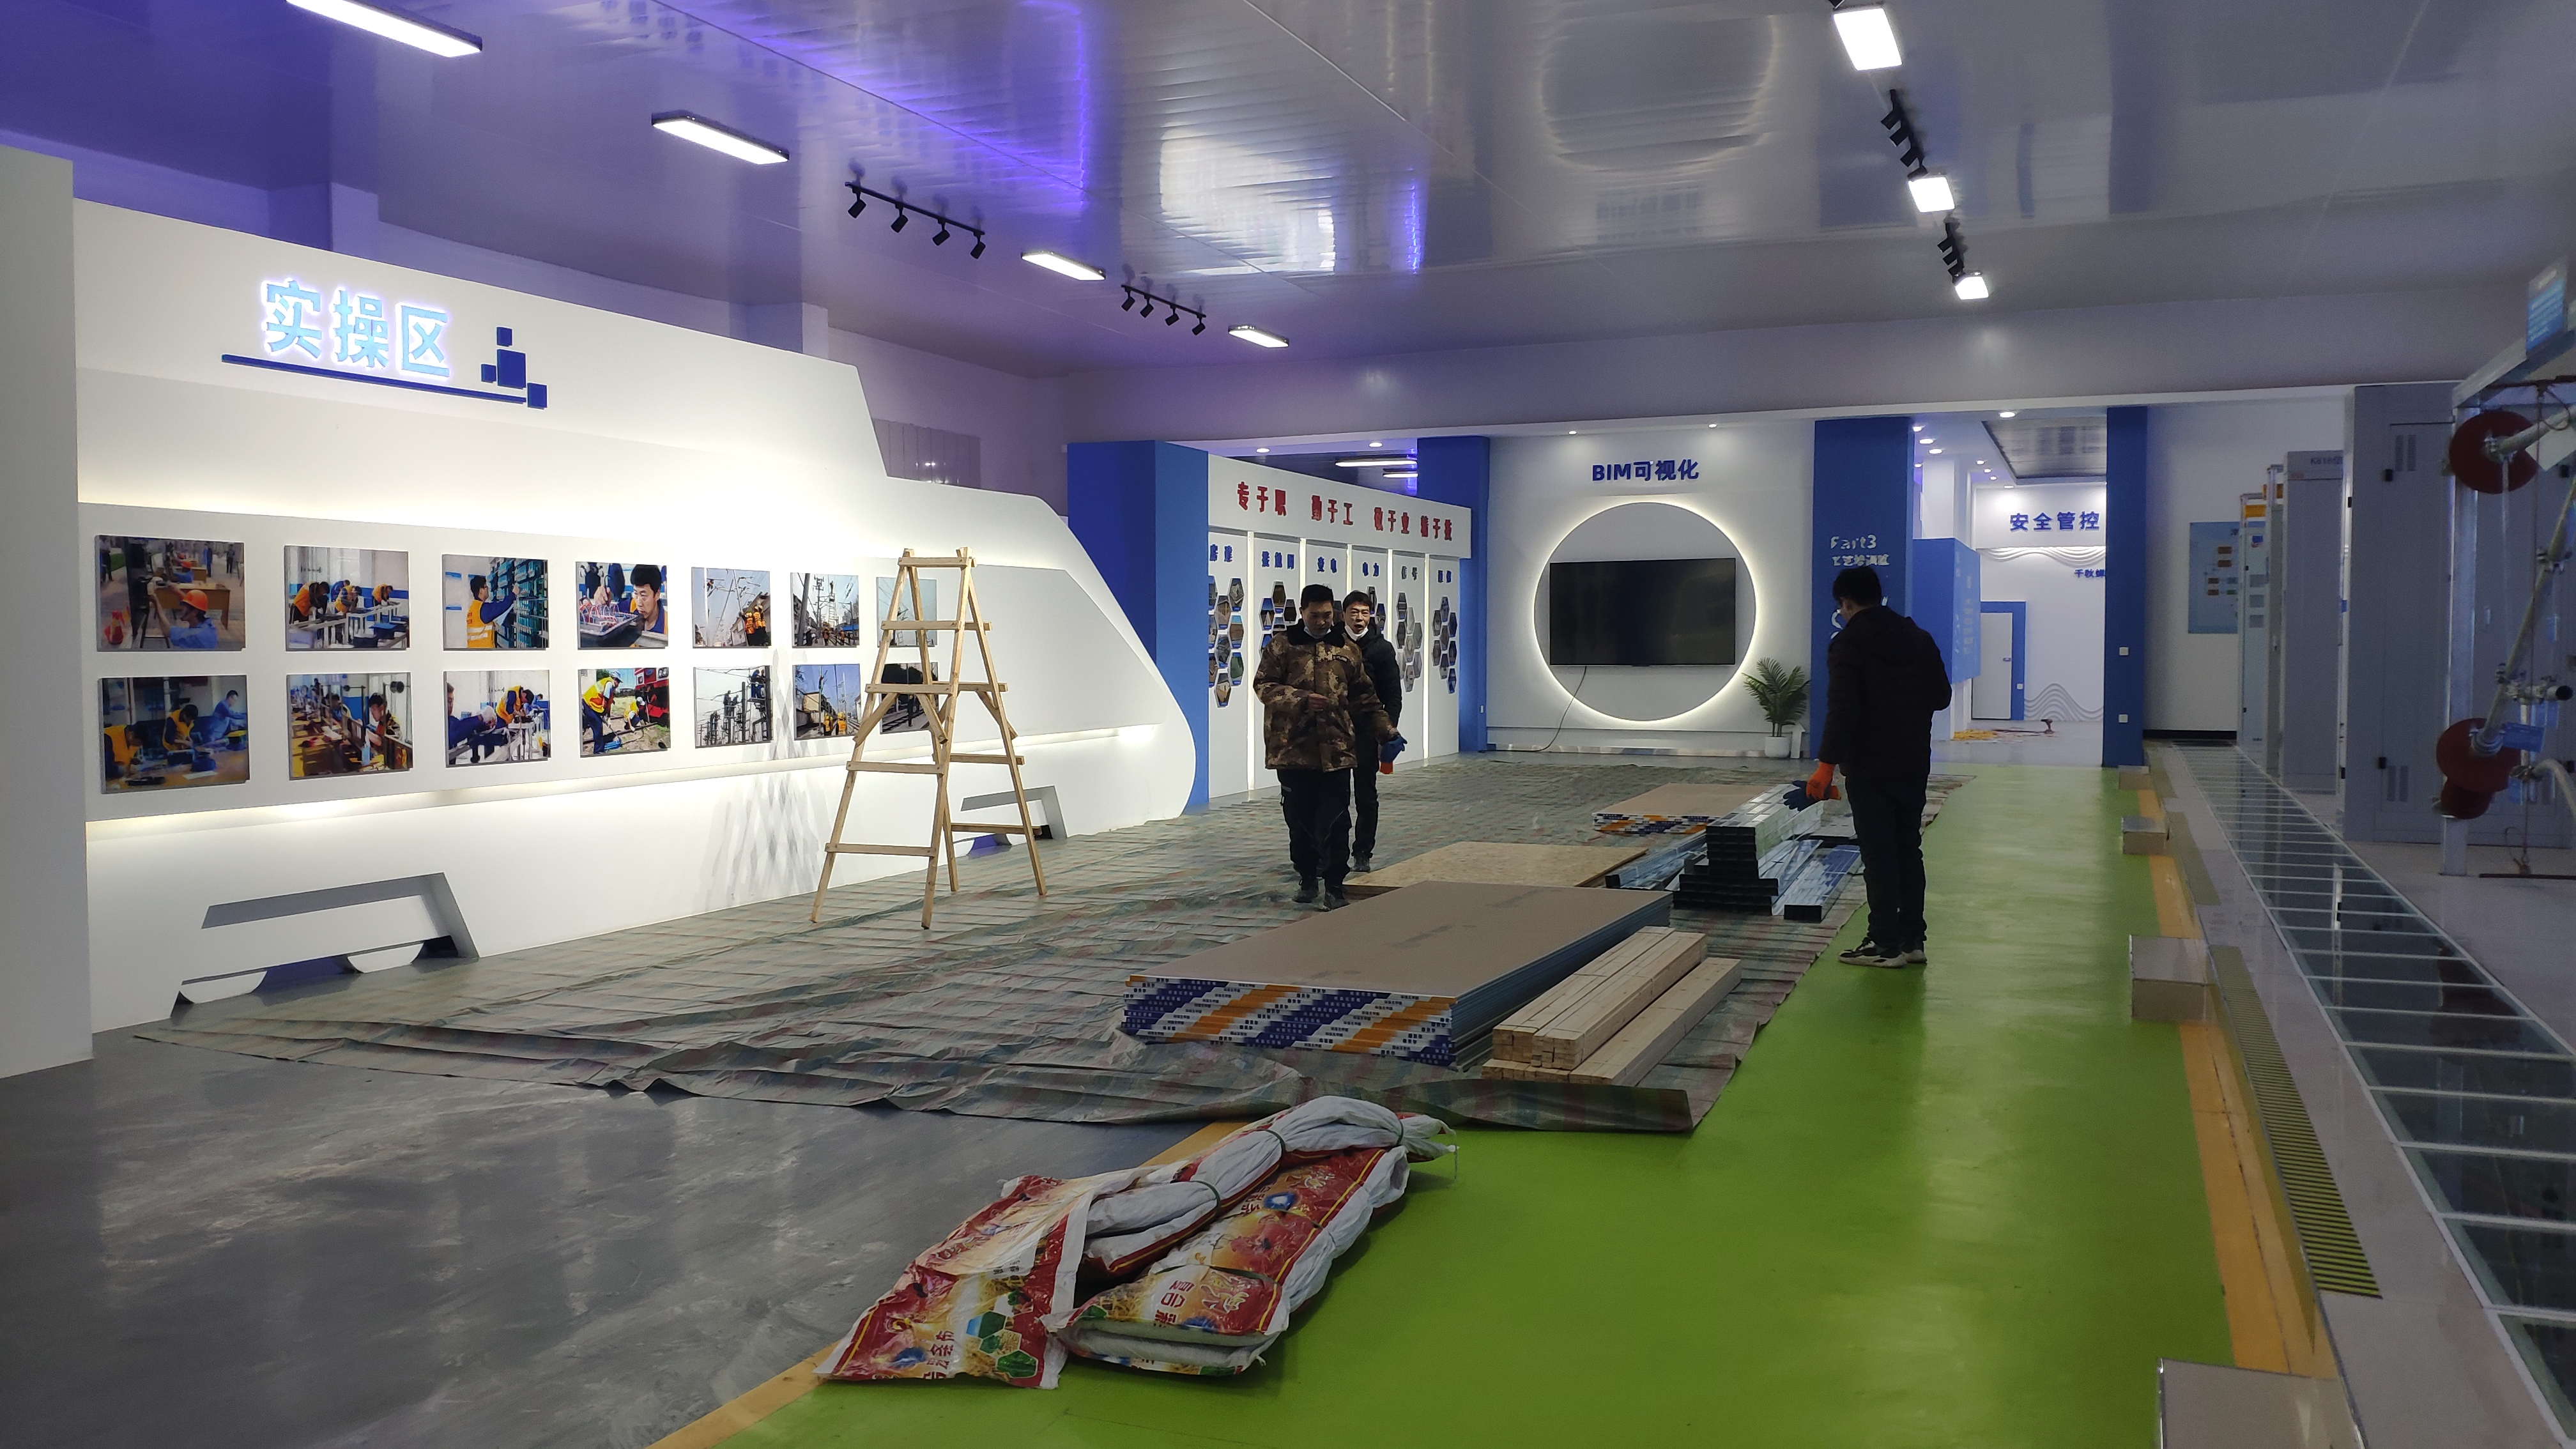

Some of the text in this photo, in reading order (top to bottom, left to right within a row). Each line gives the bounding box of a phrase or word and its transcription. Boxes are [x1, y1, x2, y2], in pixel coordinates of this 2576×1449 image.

[263, 279, 450, 378] 实操区
[1592, 459, 1699, 481] BIM可视化
[2010, 510, 2100, 532] 安全管控
